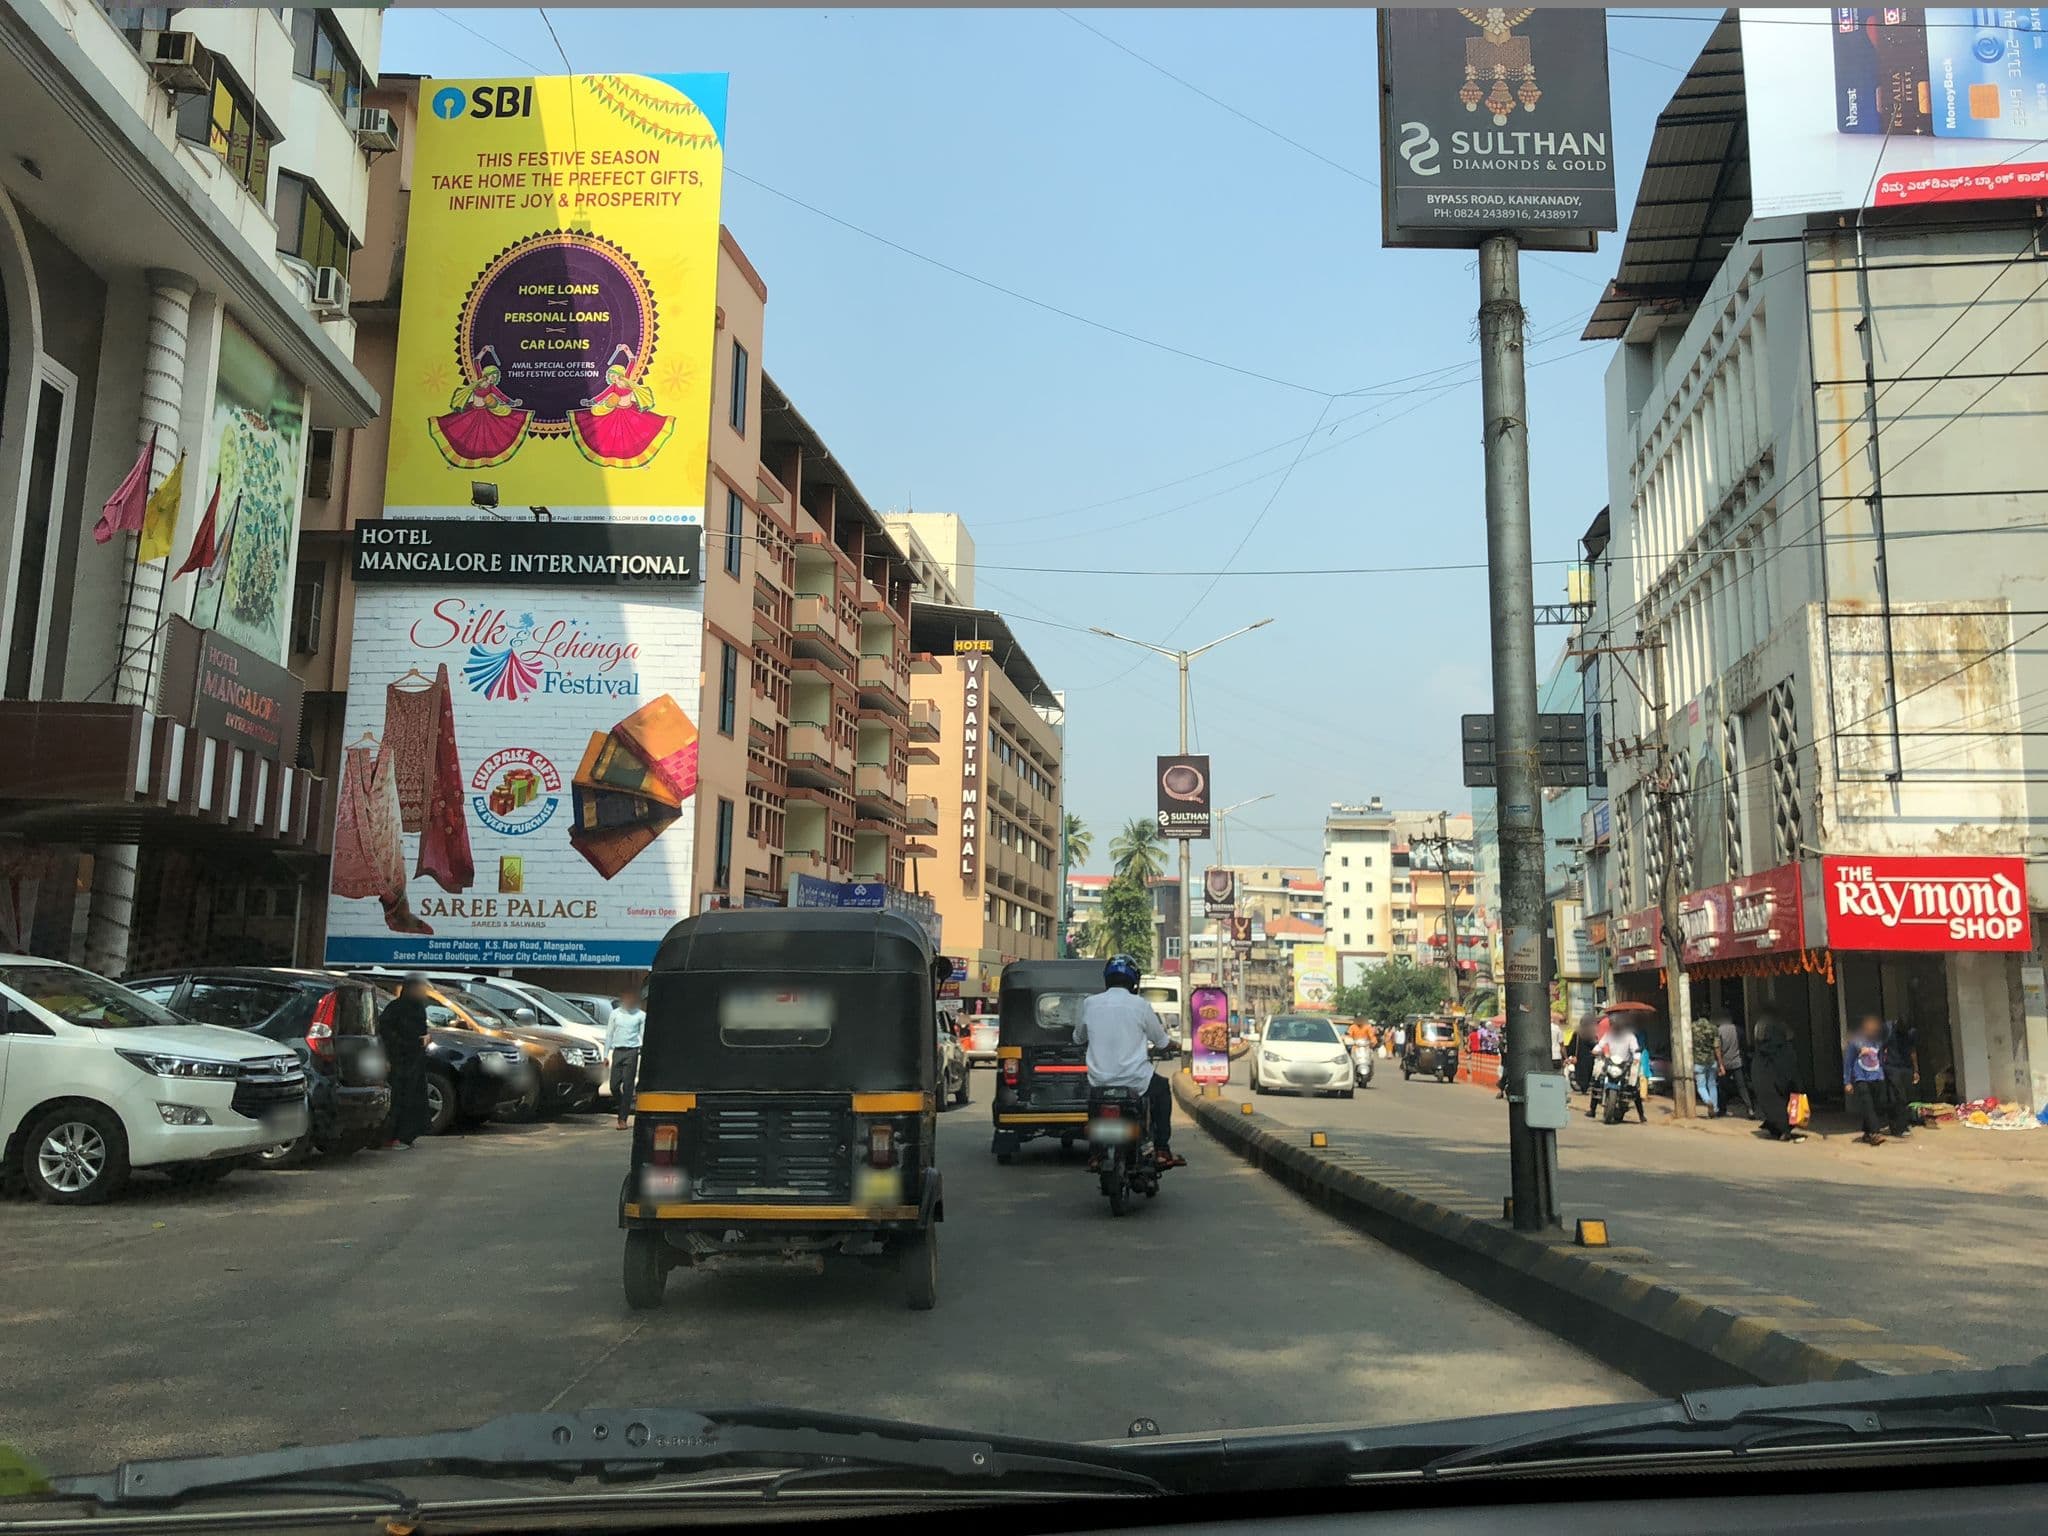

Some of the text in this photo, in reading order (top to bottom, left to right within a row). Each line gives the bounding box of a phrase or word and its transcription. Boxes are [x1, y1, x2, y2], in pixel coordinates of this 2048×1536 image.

[1904, 70, 1914, 101] FIRST
[1943, 57, 1957, 129] MoneyBack
[470, 85, 532, 119] SBI
[1451, 131, 1606, 156] SULTHAN
[477, 149, 660, 167] THIS FESTIVE SEASON
[1452, 158, 1607, 171] DIAMONDS & GOLD
[432, 170, 704, 190] TAKE HOME THE PREFECT GIFTS,
[449, 191, 682, 210] INFINITE JOY & PROSPERITY
[1426, 194, 1582, 207] BYPASS ROAD, KANKANADY,
[1434, 208, 1579, 220] PH: 0824 2438916, 2438917
[518, 284, 600, 295] HOME LOANS
[504, 311, 610, 323] PERSONAL LOANS
[520, 339, 590, 350] CAR LOANS
[507, 370, 599, 378] THIS FESTIVE OCCASION
[534, 361, 565, 369] SPECIAL
[566, 361, 596, 369] OFFERS
[361, 528, 432, 545] HOTEL
[359, 551, 691, 576] MANGALORE INTERNATIONAL
[410, 598, 508, 649] Silk
[520, 620, 641, 672] Lehenga
[954, 640, 993, 651] HOTEL
[208, 647, 240, 676] HOTEL
[542, 670, 640, 696] Festival
[474, 749, 560, 788] SURPRISE GIFTS
[962, 659, 979, 874] VASANTH MAHAL
[475, 799, 555, 834] ON EVERY PURCHASE
[1170, 812, 1209, 821] SULTHAN
[1837, 866, 1873, 881] THE
[420, 898, 598, 919] SAREE PALACE
[1834, 872, 2022, 928] Raymond
[626, 907, 677, 918] Sundays Open
[1949, 917, 2024, 940] SHOP
[428, 940, 451, 950] Saree
[452, 940, 481, 951] Palace,
[485, 940, 501, 950] K.S.
[502, 940, 518, 950] Rao
[519, 940, 542, 951] Road,
[393, 951, 416, 960] Saree
[417, 951, 445, 961] Palace
[445, 951, 481, 962] Boutique,
[494, 952, 514, 961] Floor
[515, 952, 532, 963] City
[532, 952, 558, 962] Centre
[559, 953, 578, 963] Mall,
[579, 953, 621, 964] Mangalore
